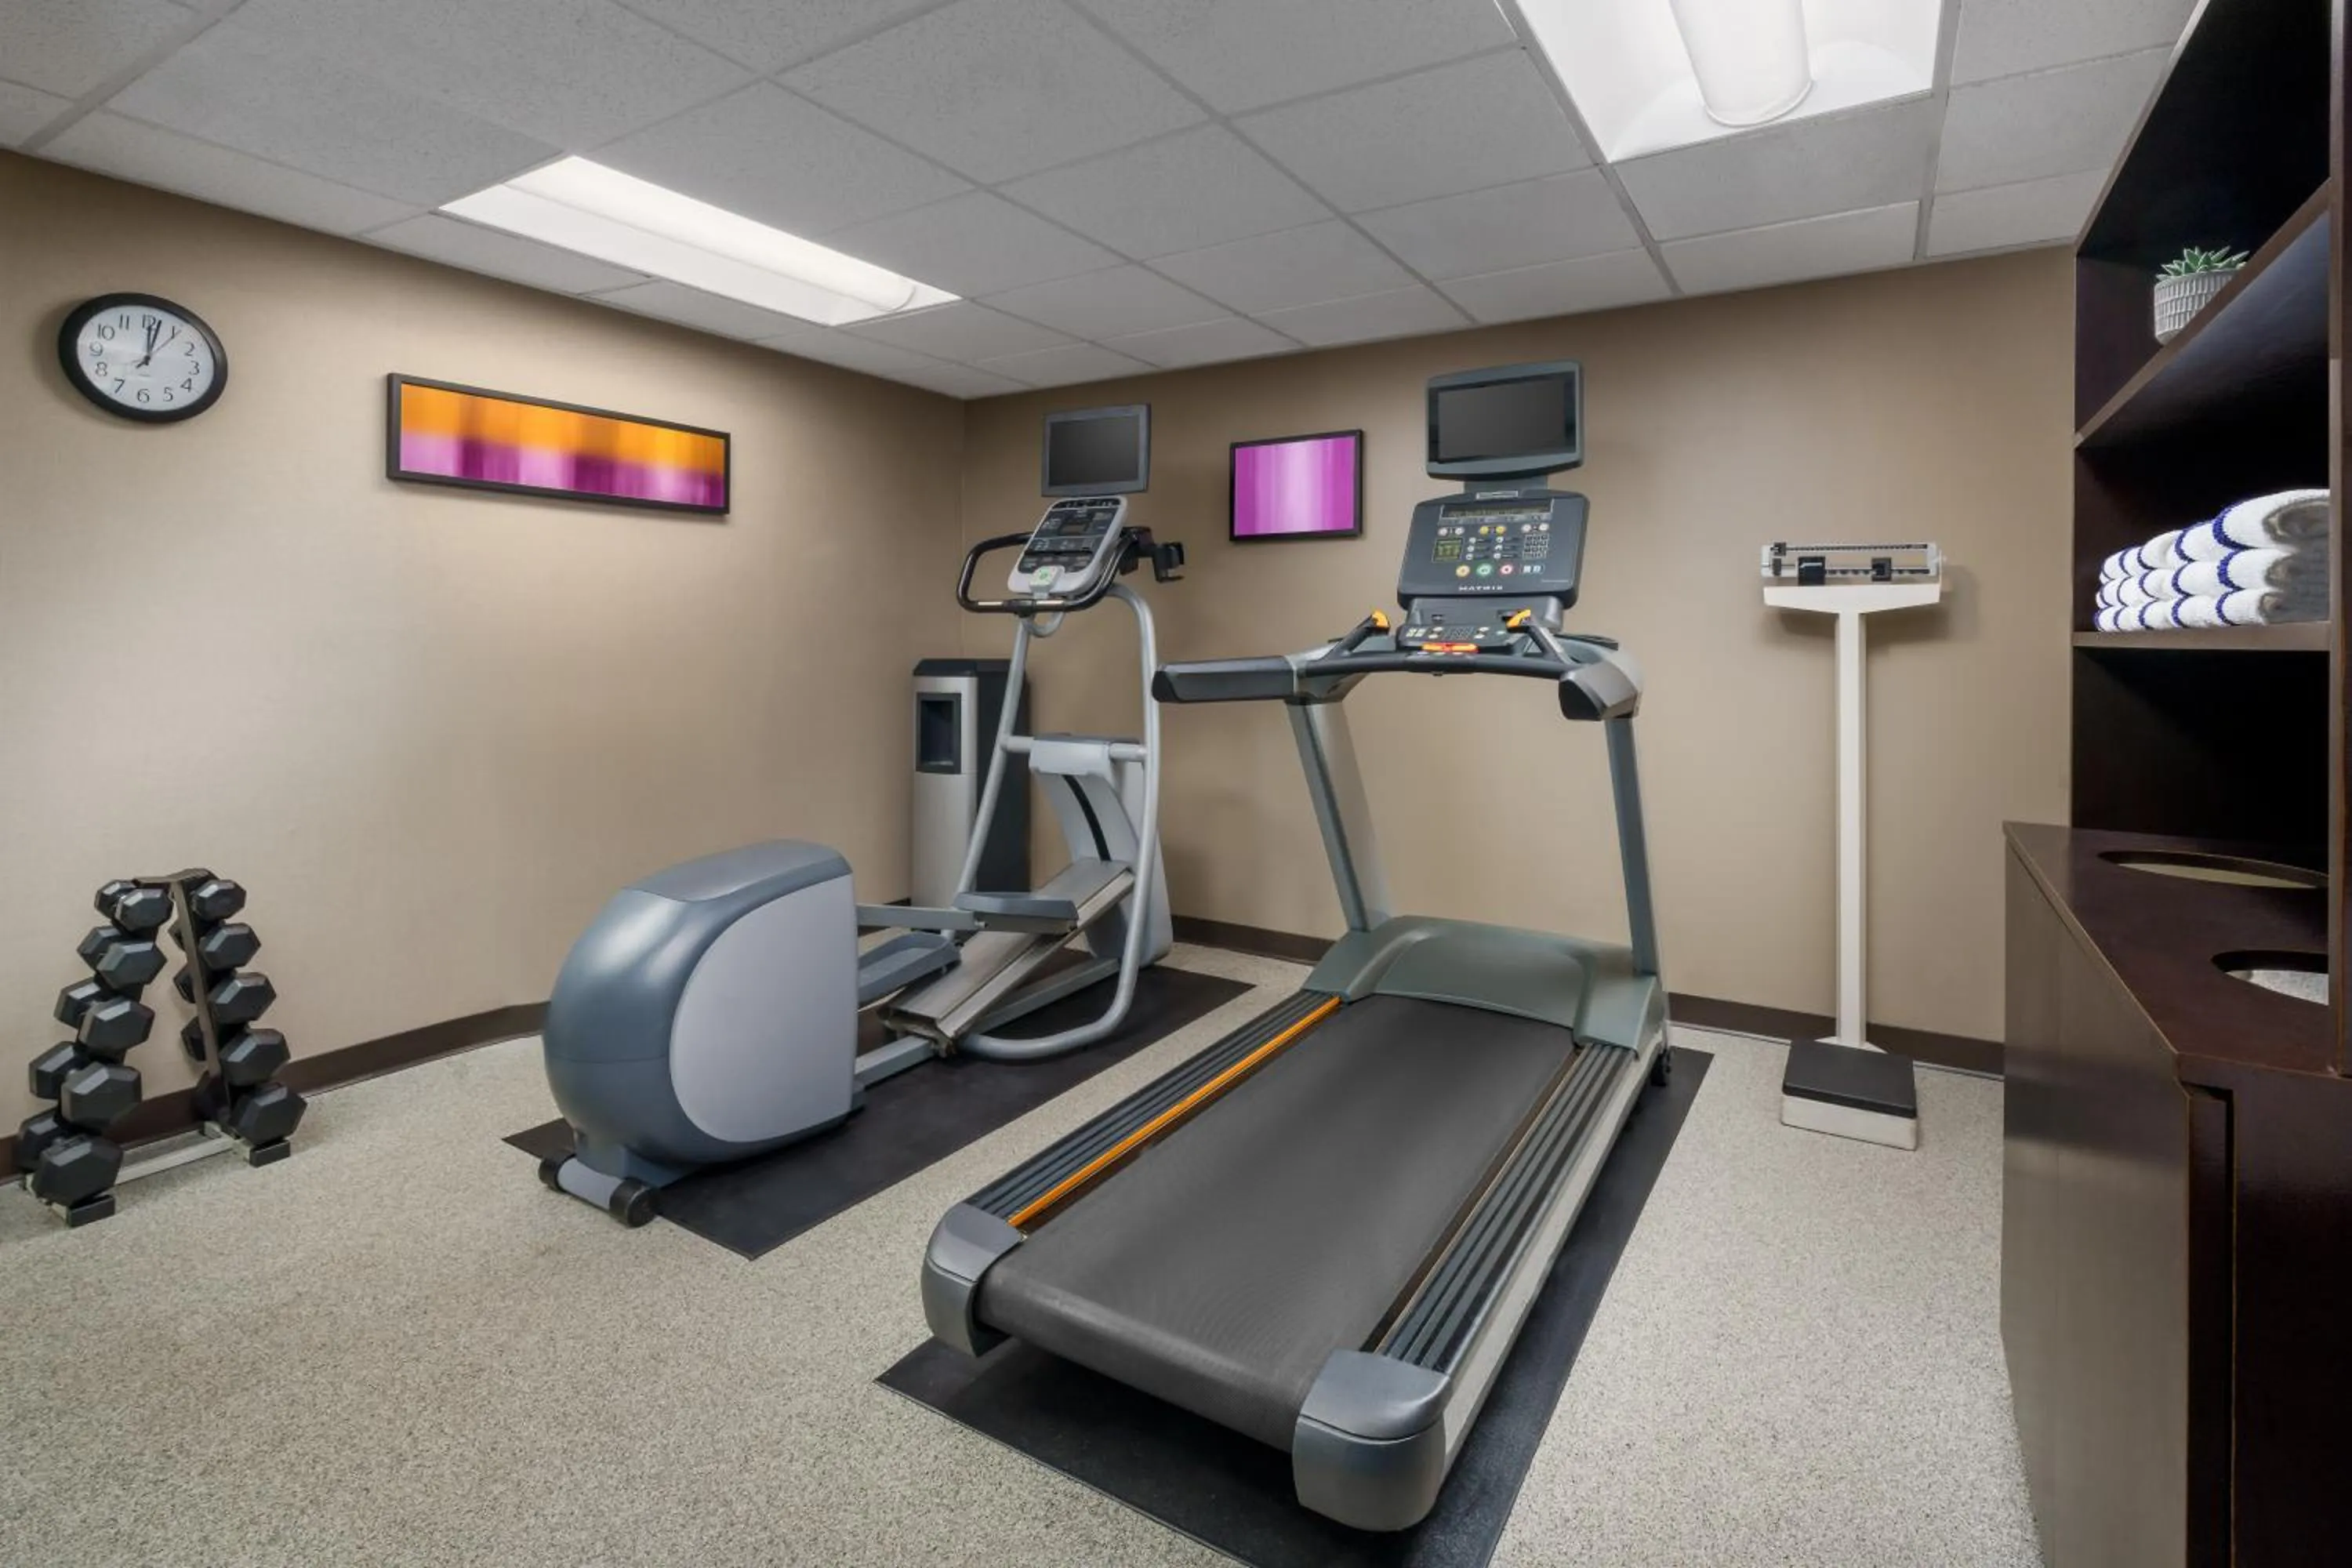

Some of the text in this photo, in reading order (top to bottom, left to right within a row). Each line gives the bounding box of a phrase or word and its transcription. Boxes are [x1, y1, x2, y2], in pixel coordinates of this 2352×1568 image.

[119, 314, 129, 330] 11
[97, 324, 115, 340] 10
[89, 342, 103, 356] 9
[184, 343, 195, 356] 2
[96, 362, 107, 376] 8
[189, 361, 200, 376] 3
[114, 378, 125, 394] 7
[180, 378, 192, 393] 4
[137, 388, 150, 403] 6
[163, 387, 173, 402] 5
